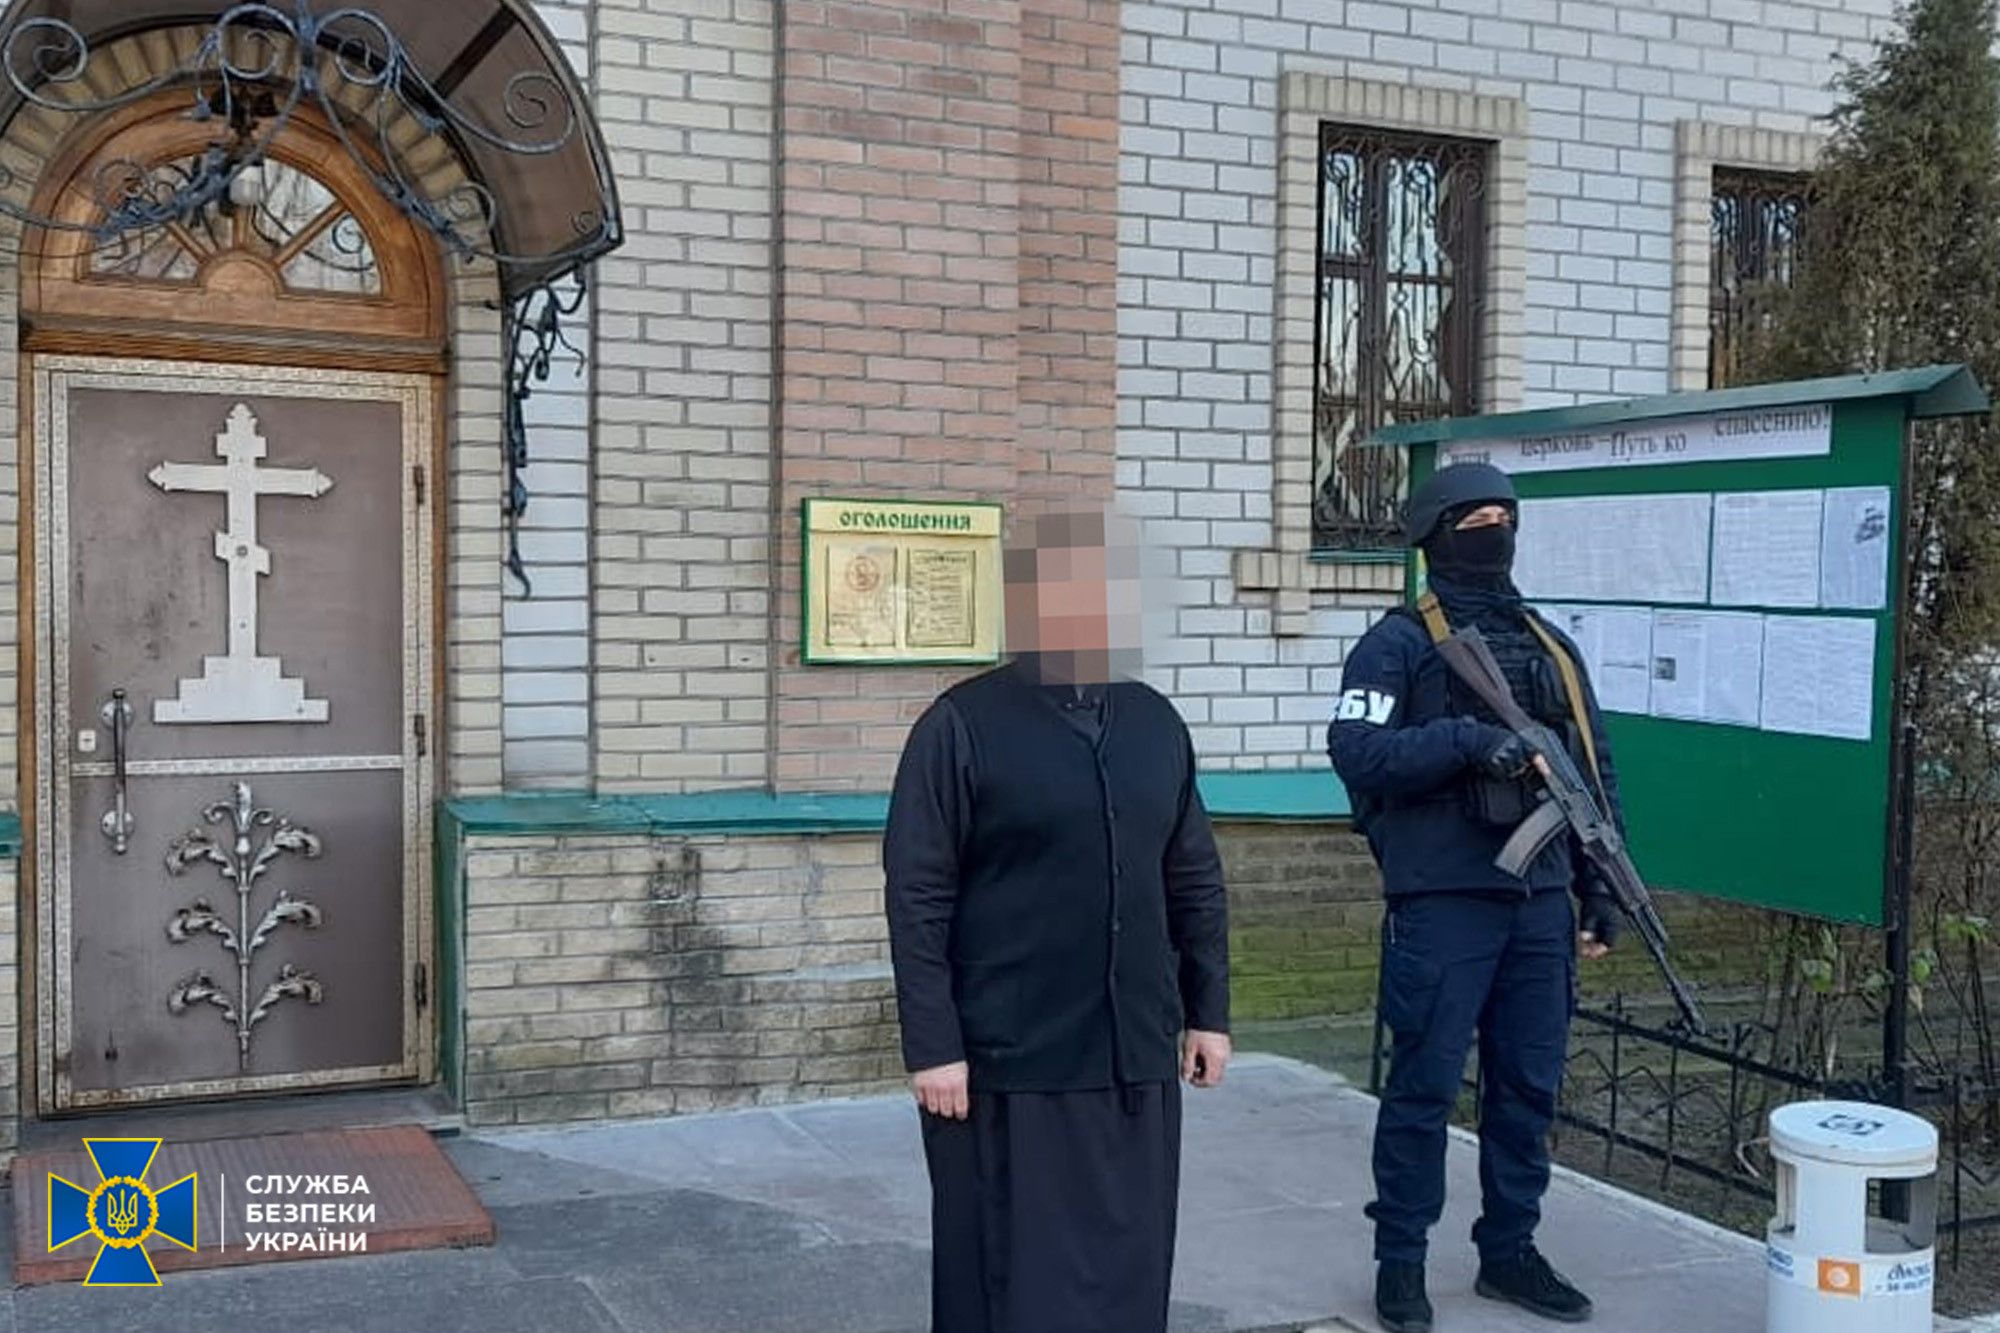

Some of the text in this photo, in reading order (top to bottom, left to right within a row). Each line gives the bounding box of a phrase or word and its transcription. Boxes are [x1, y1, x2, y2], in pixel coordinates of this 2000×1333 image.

[1521, 435, 1595, 461] церковь
[1611, 431, 1657, 461] Путь
[1663, 433, 1687, 453] ко
[1334, 688, 1396, 725] БУ
